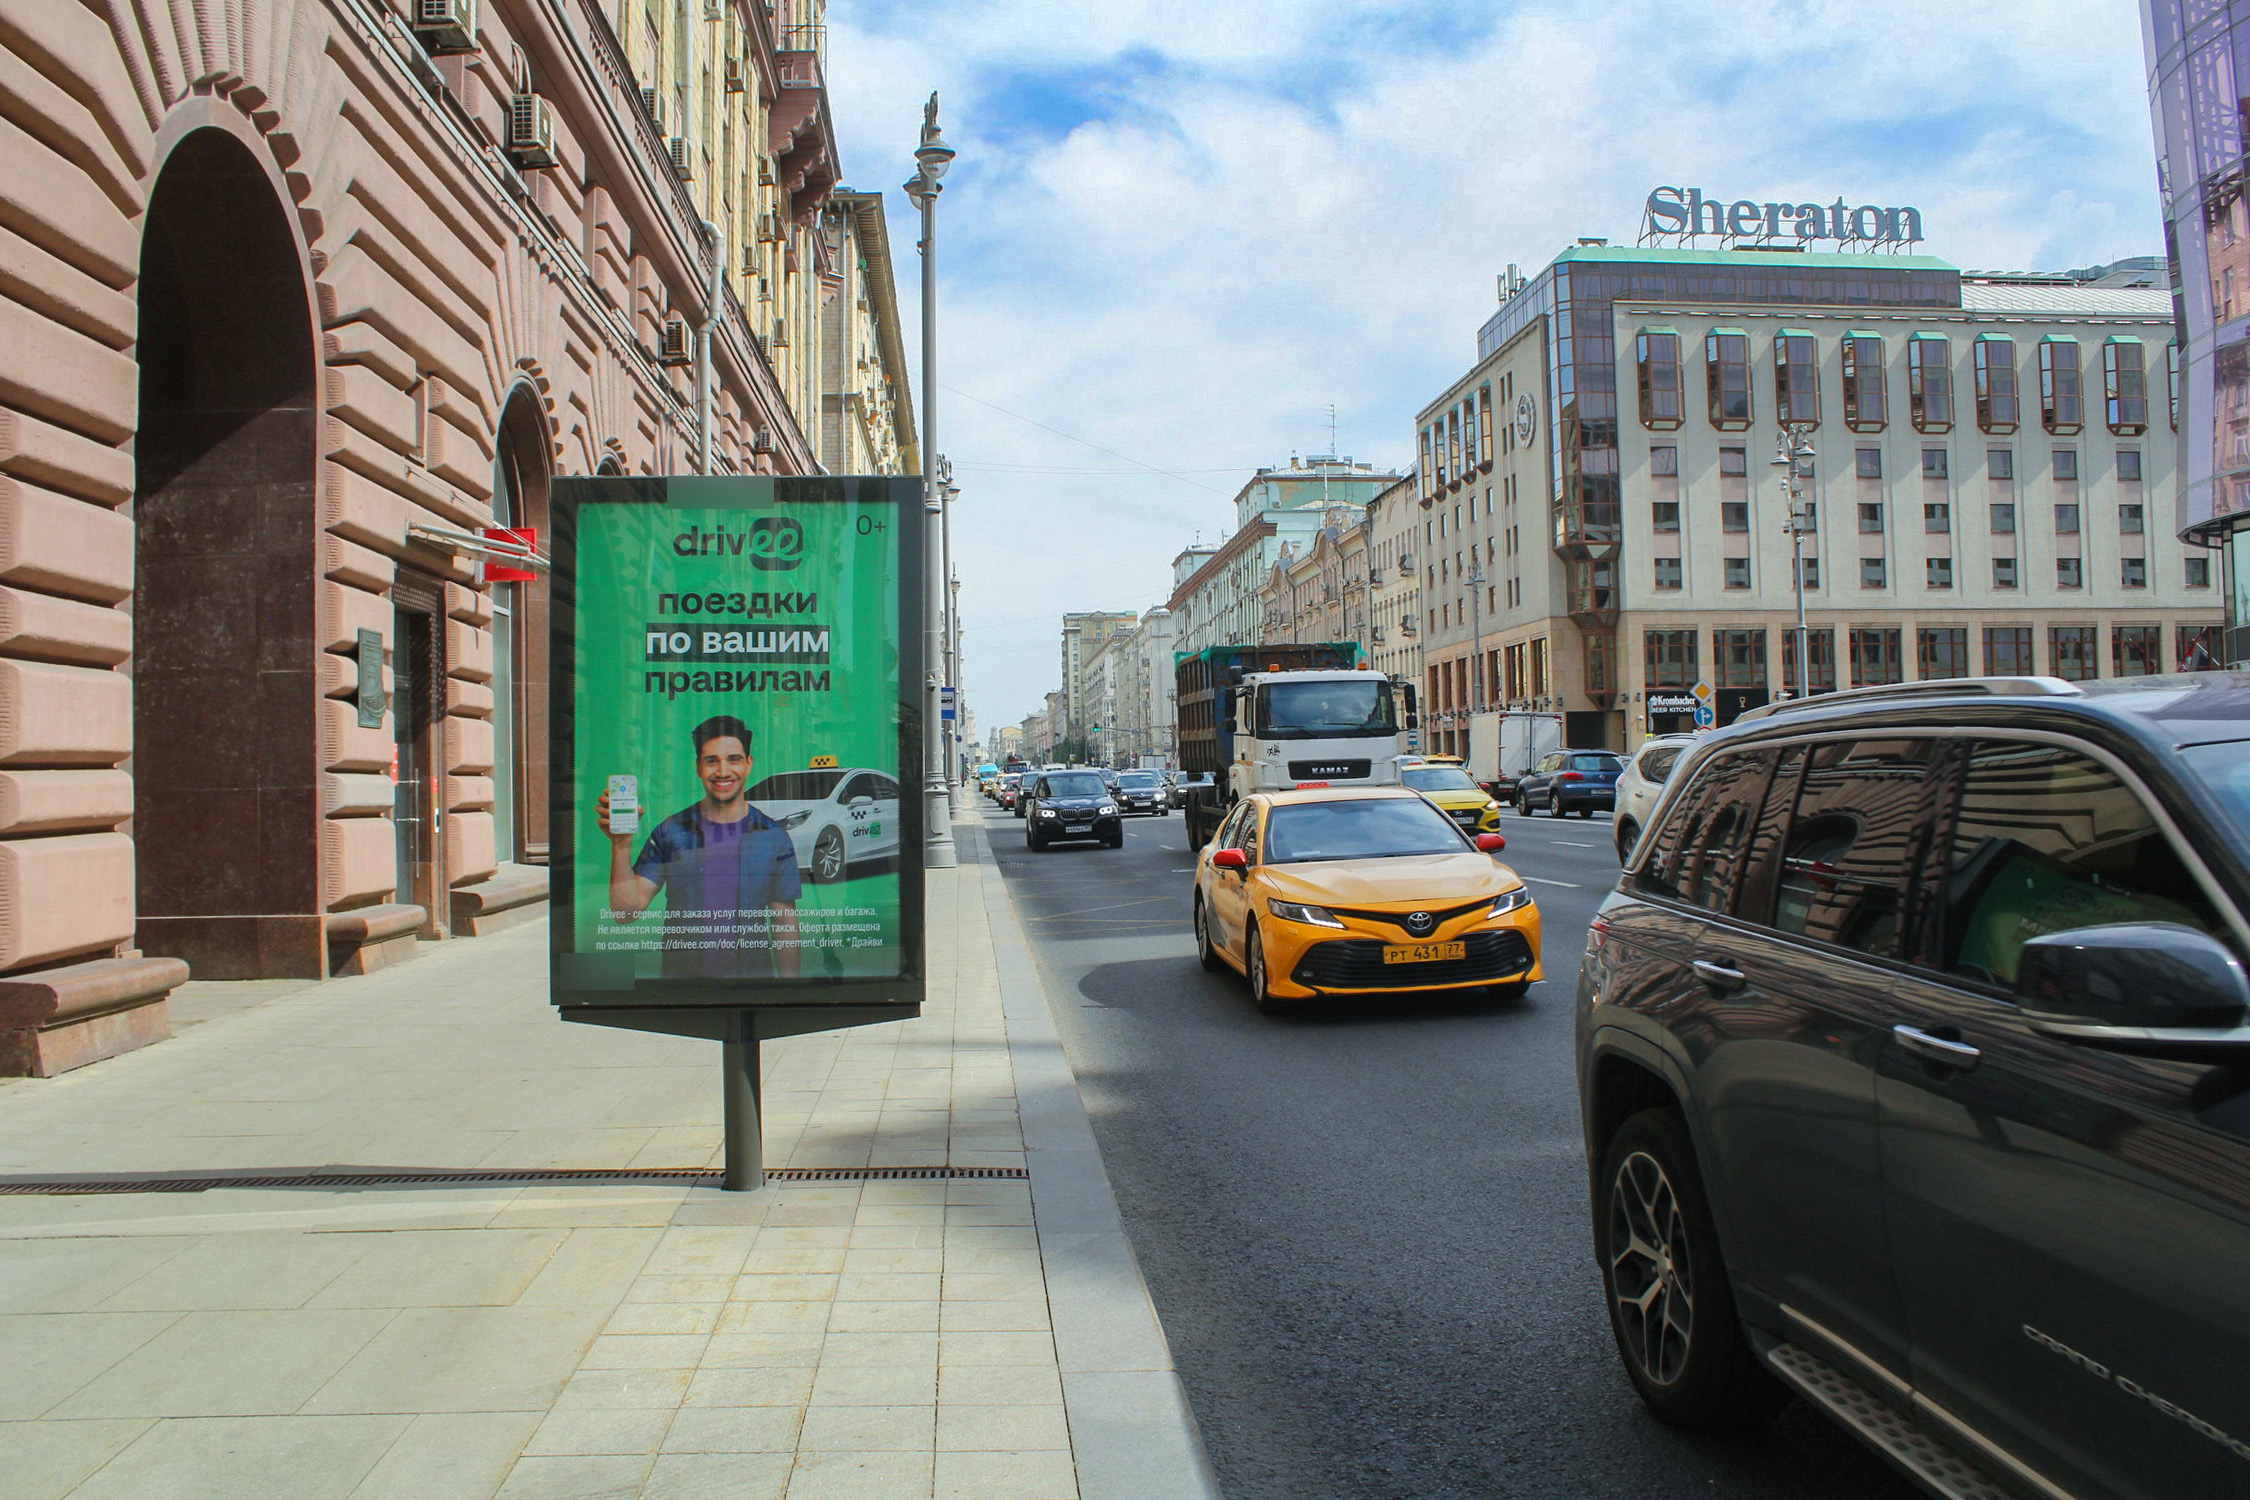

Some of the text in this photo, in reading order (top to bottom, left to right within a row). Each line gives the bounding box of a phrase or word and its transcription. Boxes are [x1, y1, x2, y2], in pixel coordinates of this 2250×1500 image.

[1649, 185, 1925, 242] Sheraton
[856, 514, 887, 536] 0+
[673, 524, 803, 563] drivee
[658, 592, 818, 619] поездки
[646, 630, 829, 655] по вашим
[645, 669, 831, 700] правилам
[1658, 695, 1696, 705] Krombacher
[1311, 766, 1349, 774] KAMAZ
[600, 908, 626, 919] Drivee
[632, 910, 662, 920] сервис
[664, 909, 680, 919] для
[682, 909, 711, 918] заказа
[713, 909, 737, 920] услуг
[738, 908, 783, 919] перевозки
[784, 907, 835, 918] пассажиров
[837, 908, 843, 917] и
[844, 906, 877, 916] багажа.
[597, 921, 881, 935] Не является перевозчиком или службой такси. Оферта размещена
[595, 941, 606, 951] по
[607, 941, 640, 950] ссылке
[1413, 945, 1439, 960] 431
[1447, 943, 1460, 954] 77
